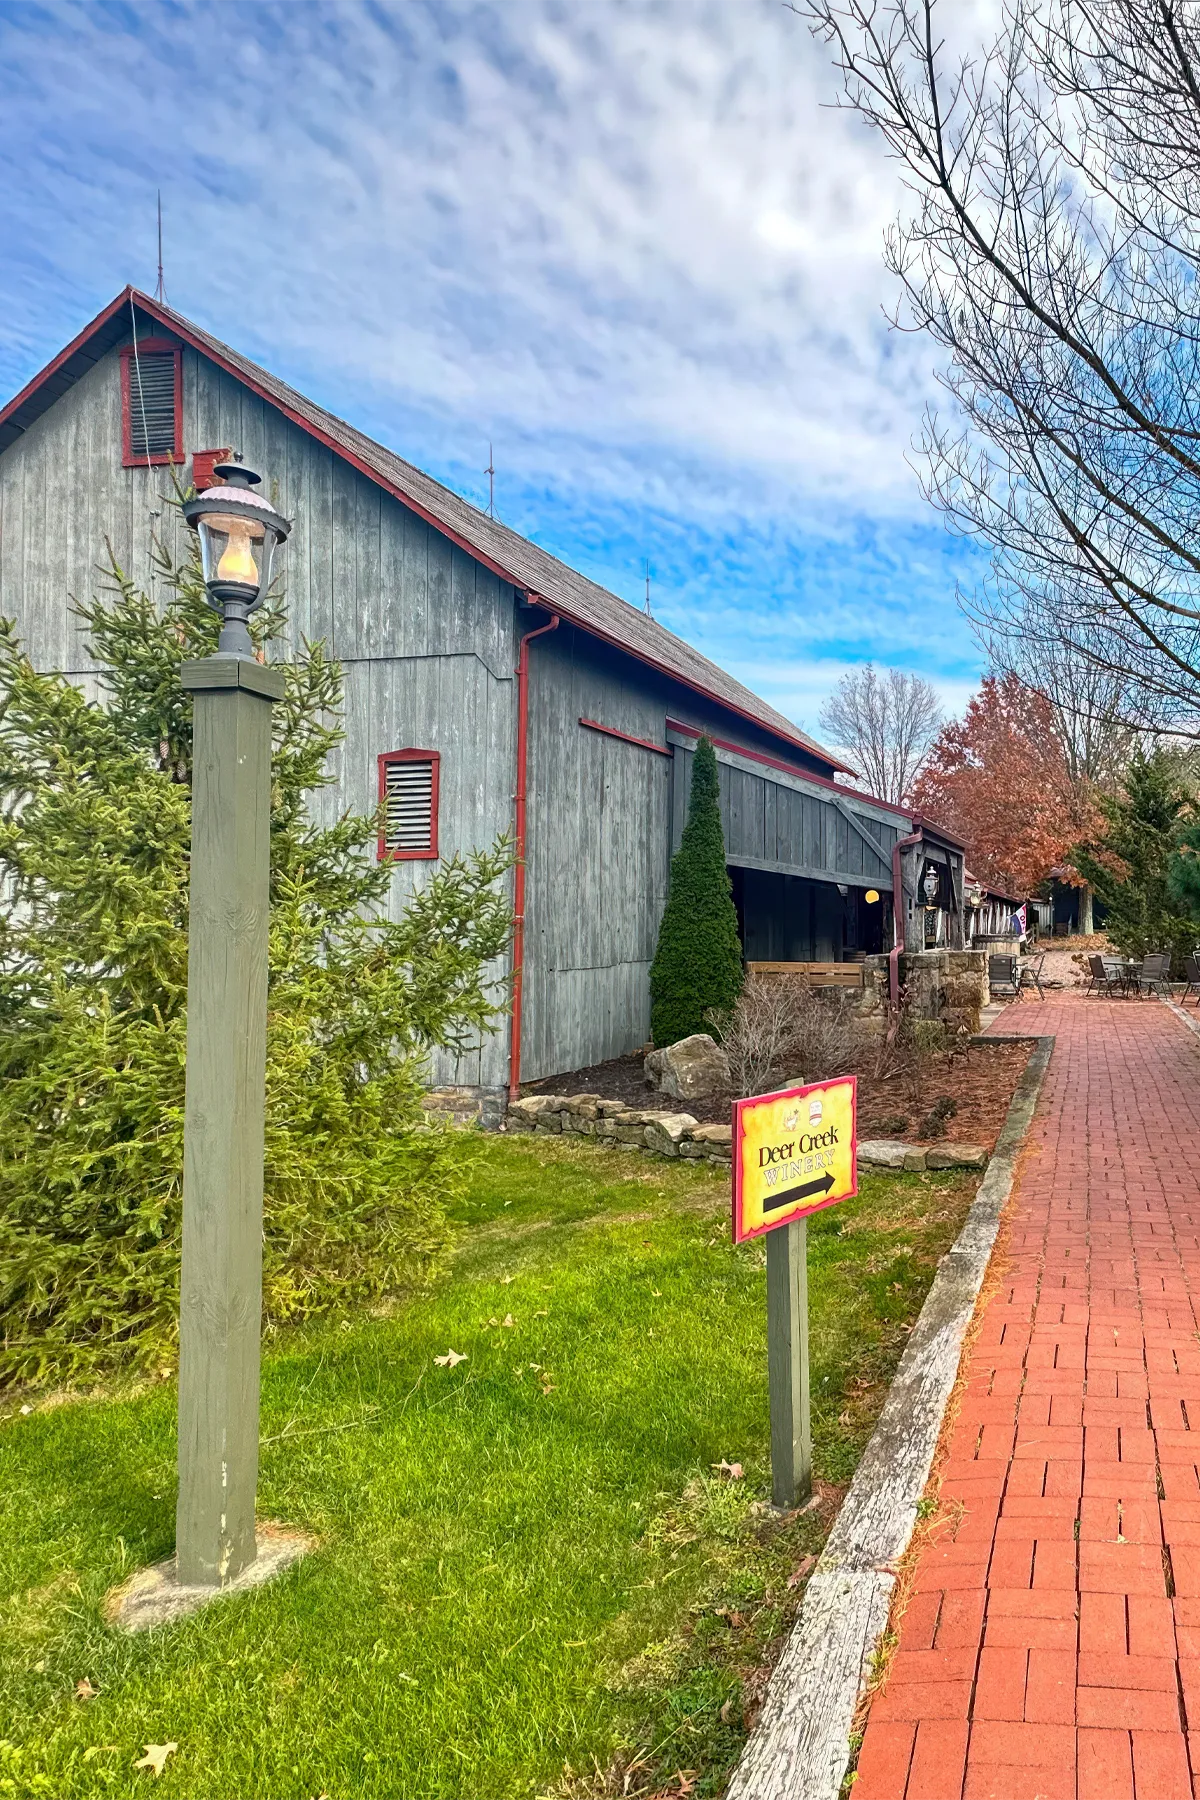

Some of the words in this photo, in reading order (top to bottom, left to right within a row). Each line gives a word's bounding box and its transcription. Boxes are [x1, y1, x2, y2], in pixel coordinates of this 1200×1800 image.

[758, 1142, 795, 1167] Deer
[799, 1126, 839, 1153] Creek
[764, 1149, 835, 1187] WINERY
